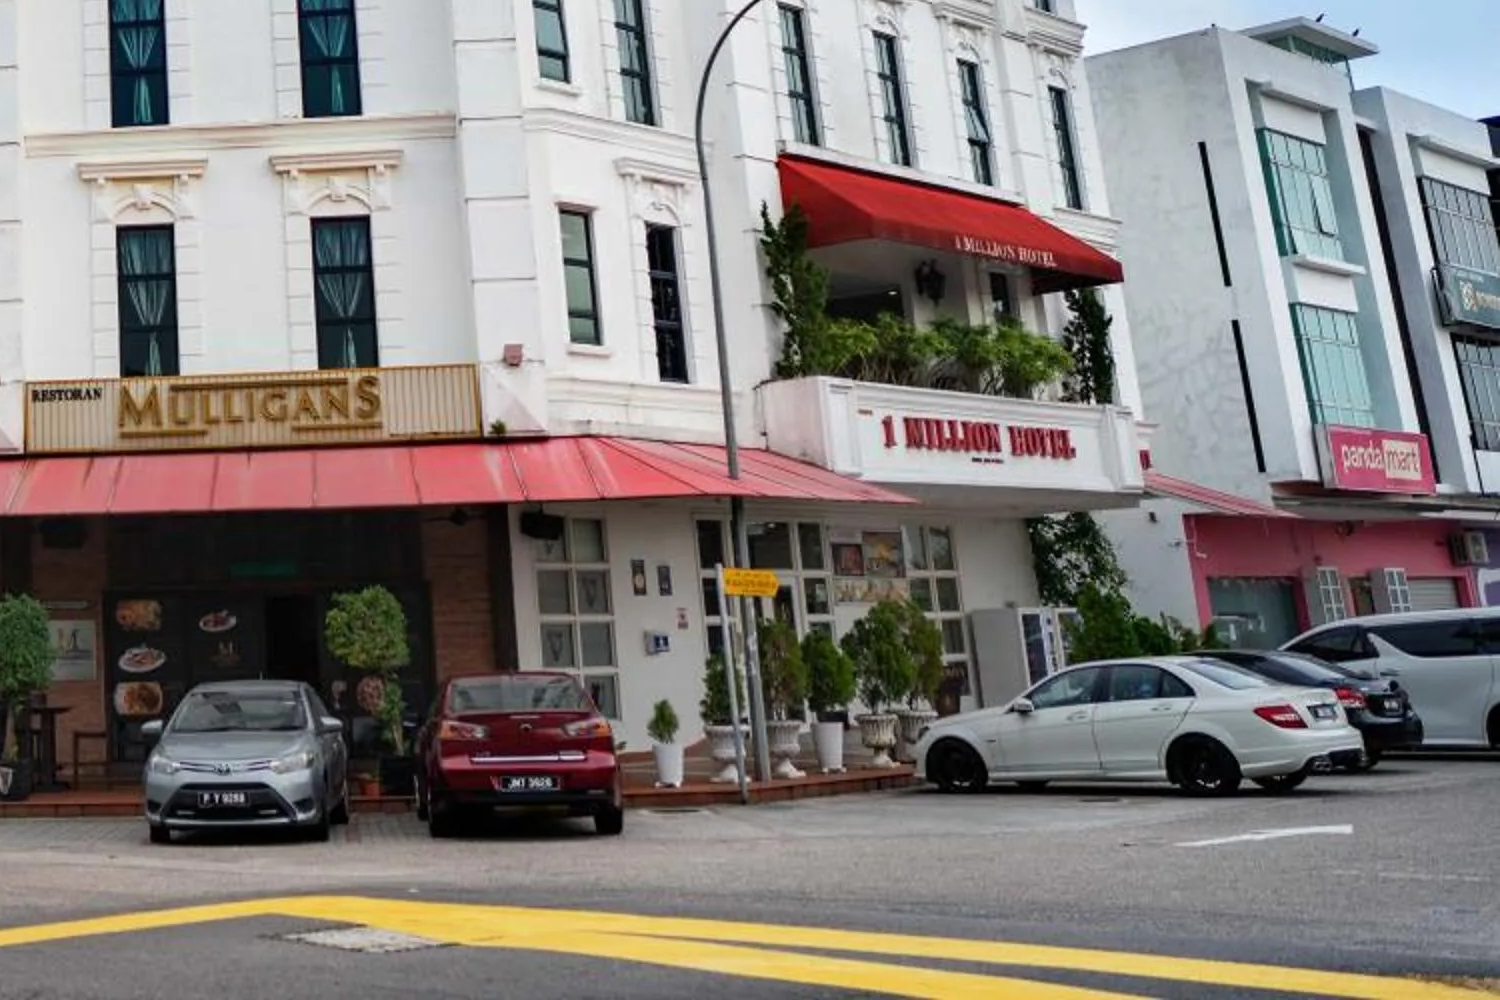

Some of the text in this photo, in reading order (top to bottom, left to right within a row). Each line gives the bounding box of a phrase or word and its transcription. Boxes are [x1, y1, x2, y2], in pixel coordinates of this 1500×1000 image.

[963, 234, 1016, 260] MILLION
[1017, 246, 1058, 268] HOTEL
[31, 376, 382, 428] RESTORAN MULLIGANS
[882, 415, 1077, 460] 1 MILLION HOTEL
[1341, 439, 1419, 473] panda mart
